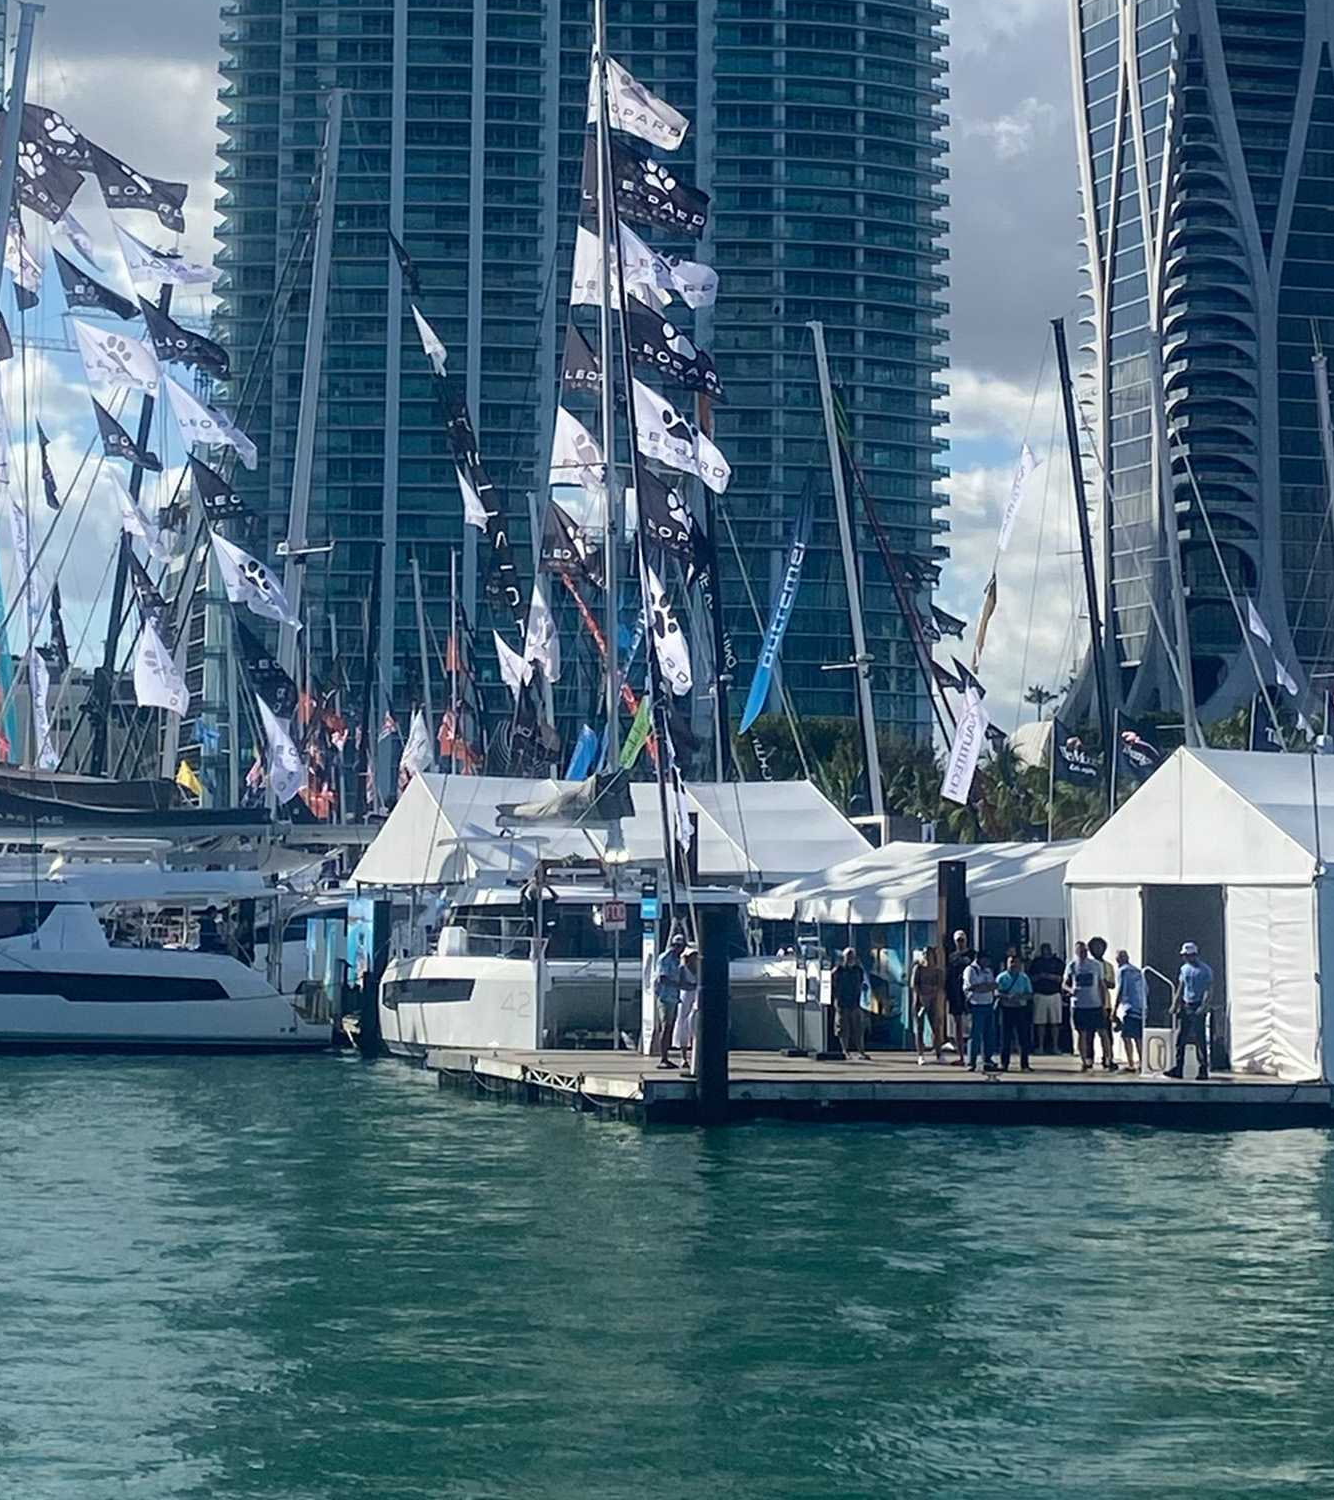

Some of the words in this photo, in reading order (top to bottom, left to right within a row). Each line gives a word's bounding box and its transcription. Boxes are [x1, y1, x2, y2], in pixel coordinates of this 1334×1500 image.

[610, 102, 682, 138] OPARD
[36, 814, 65, 825] 45
[500, 988, 532, 1019] 42
